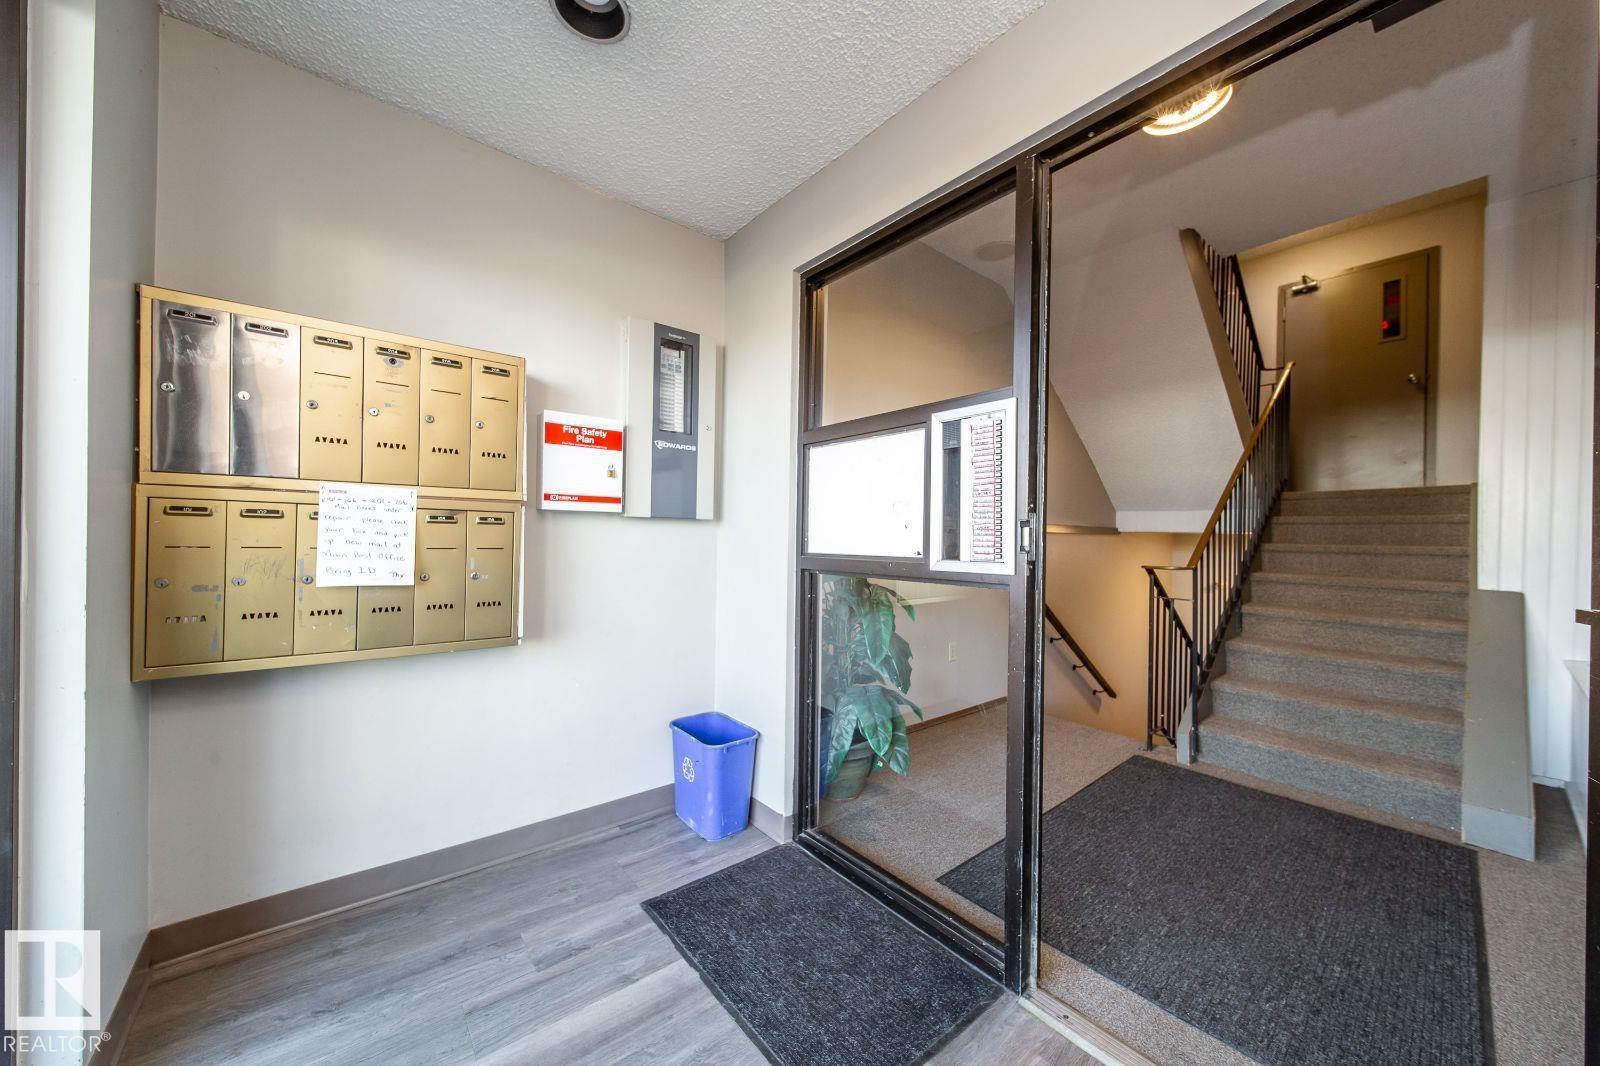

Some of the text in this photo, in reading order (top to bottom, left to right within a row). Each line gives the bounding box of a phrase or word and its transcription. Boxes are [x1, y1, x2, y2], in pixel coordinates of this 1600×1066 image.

[563, 425, 607, 438] Fire Safety
[576, 434, 595, 444] Plan
[654, 440, 697, 451] EDWARDS
[326, 566, 352, 577] Bring
